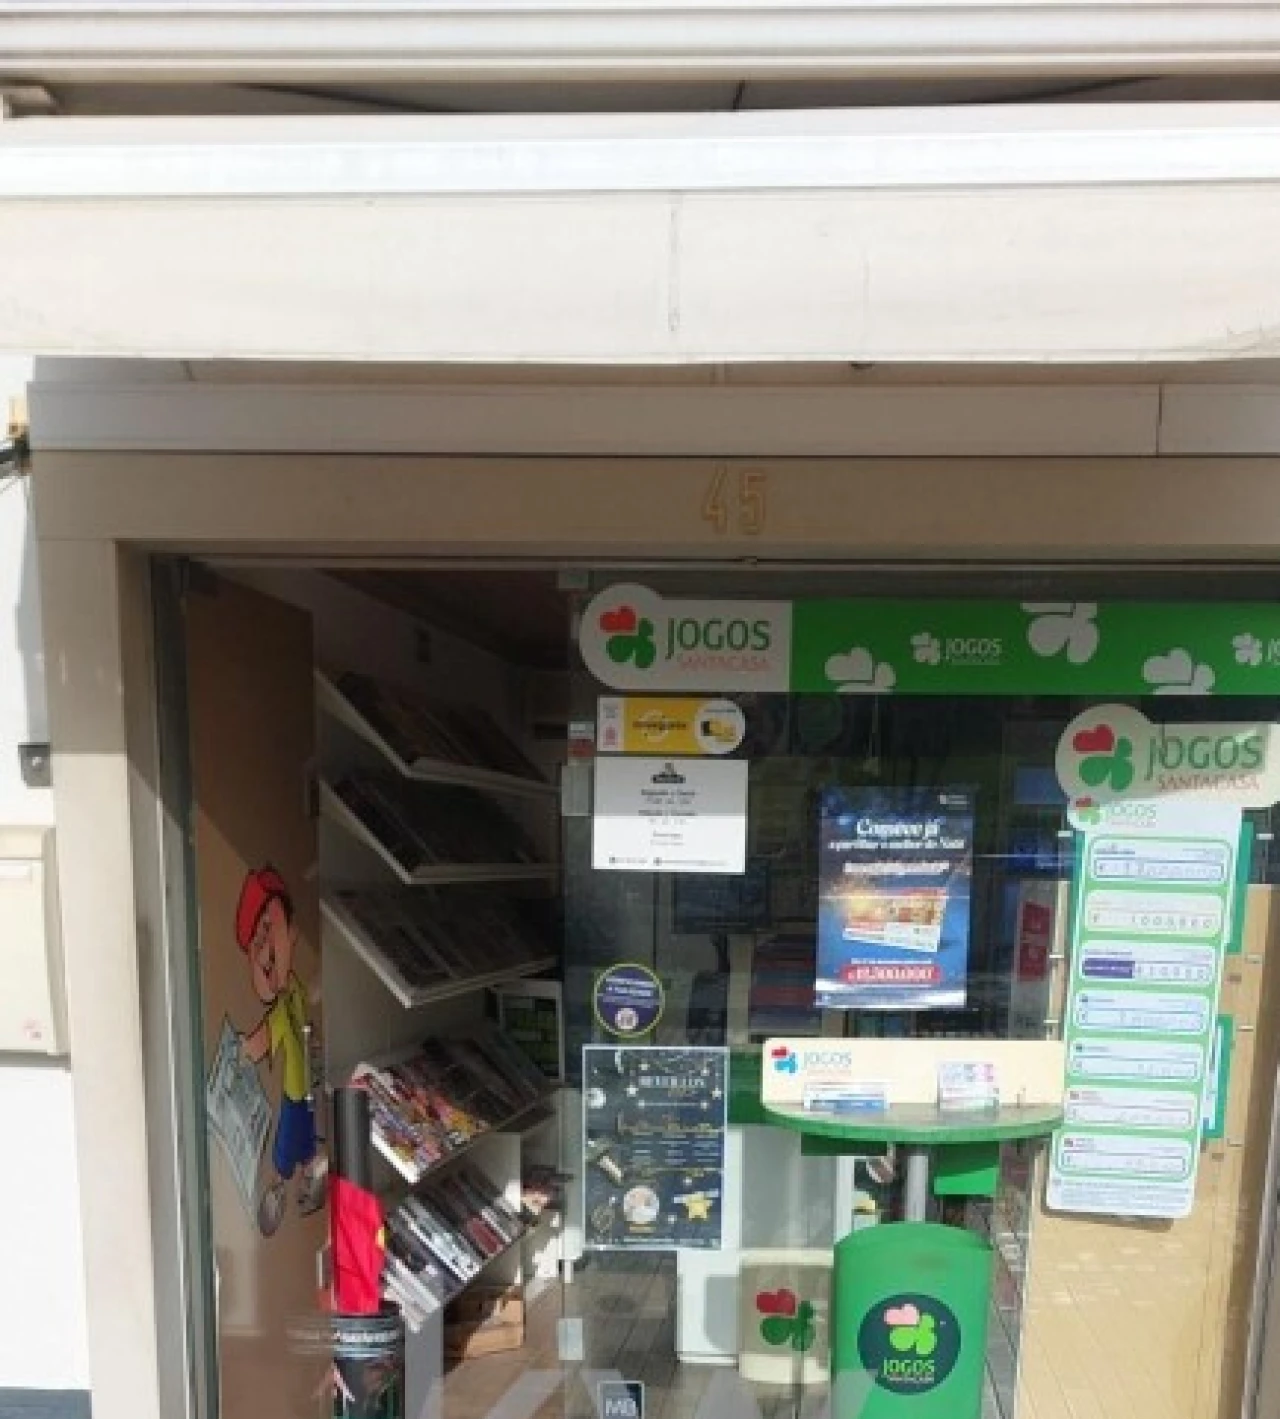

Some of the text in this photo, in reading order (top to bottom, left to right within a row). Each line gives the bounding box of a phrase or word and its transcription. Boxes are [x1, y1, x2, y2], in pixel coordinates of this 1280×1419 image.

[700, 467, 769, 535] 45
[665, 616, 772, 660] JOGOS
[945, 637, 1003, 659] JOGOS
[1144, 735, 1264, 781] JOGOS
[803, 1051, 852, 1070] JOGOS
[883, 1357, 935, 1376] JOGOS
